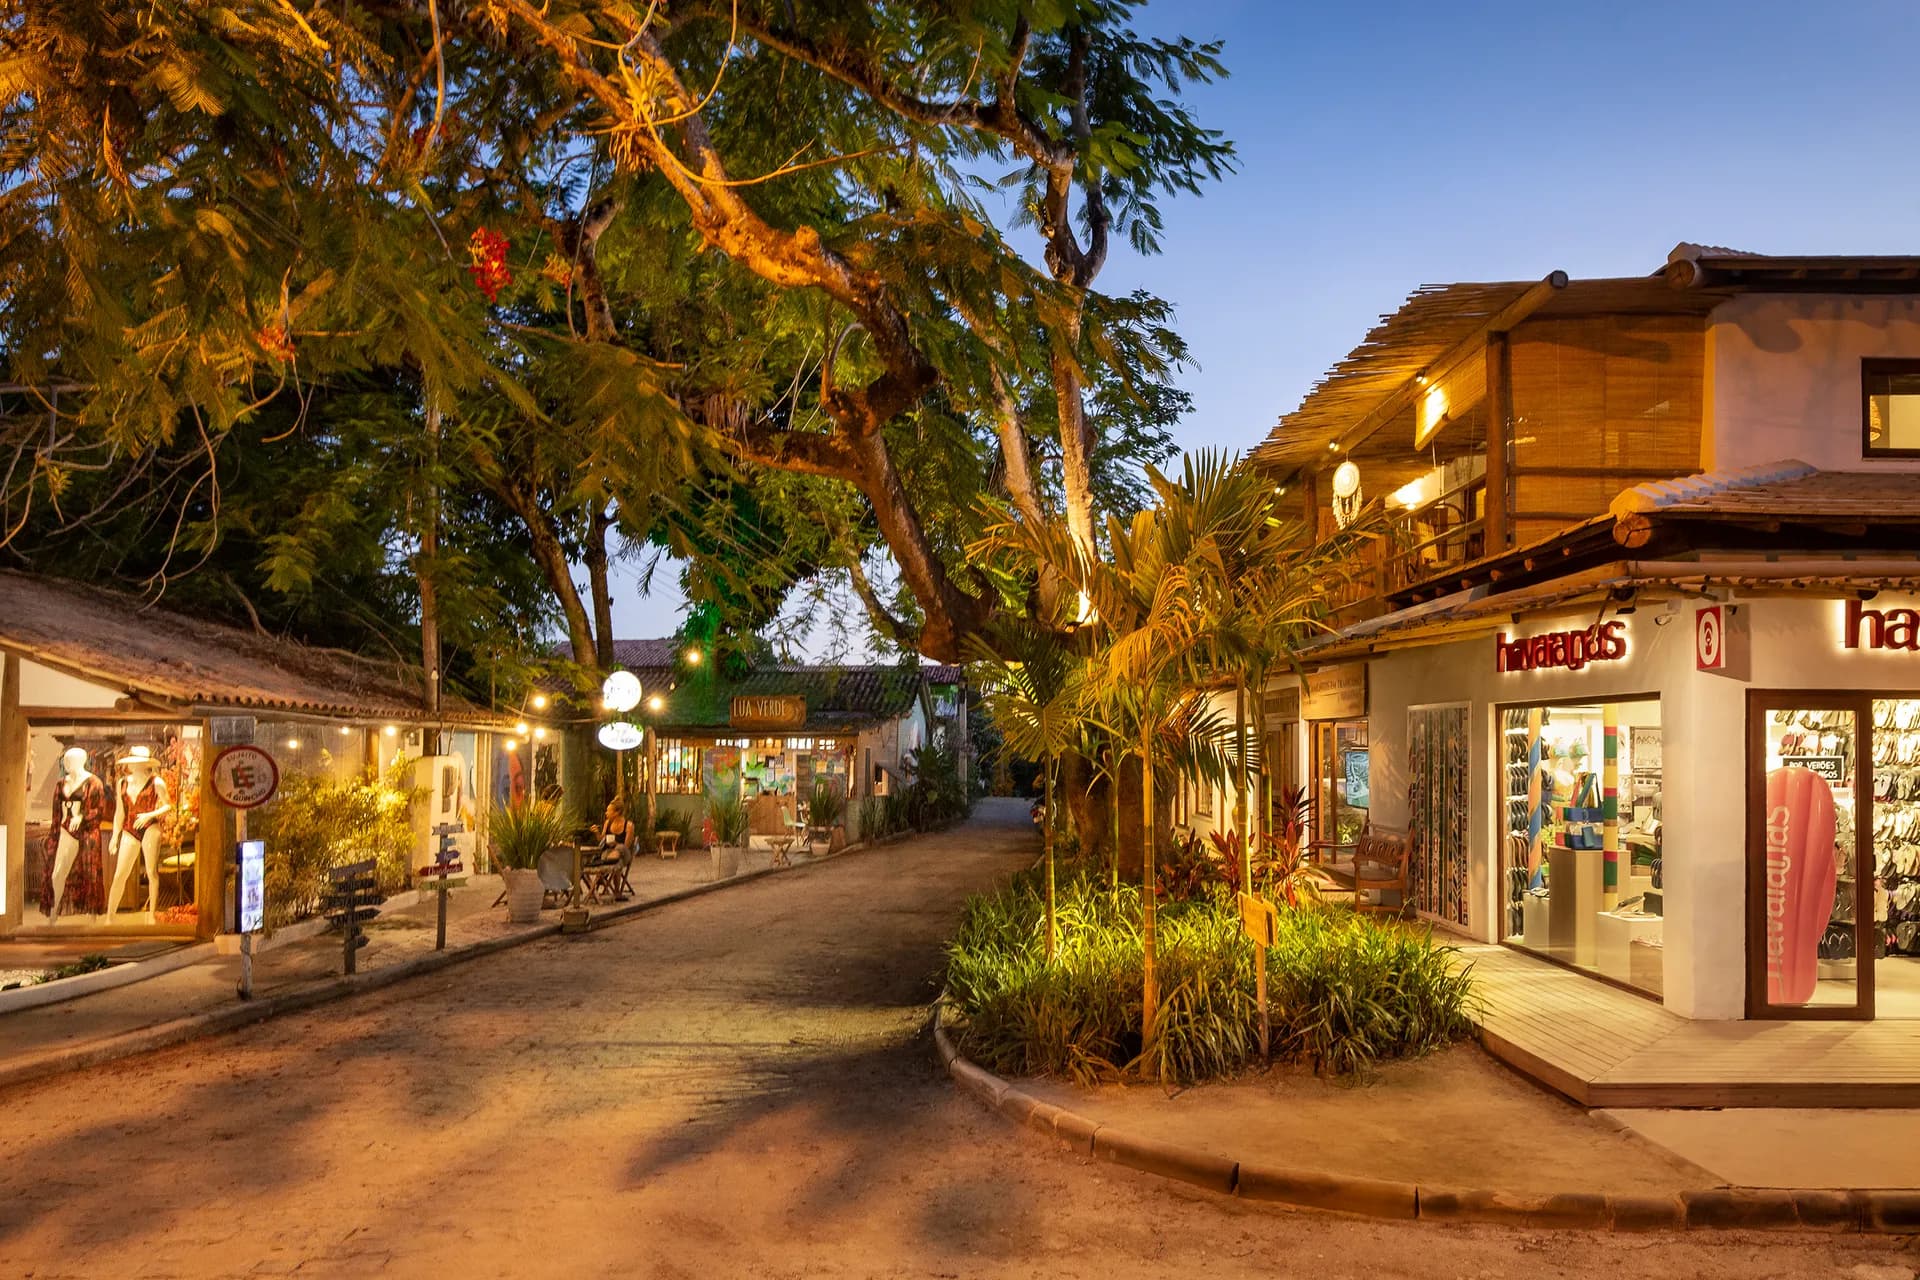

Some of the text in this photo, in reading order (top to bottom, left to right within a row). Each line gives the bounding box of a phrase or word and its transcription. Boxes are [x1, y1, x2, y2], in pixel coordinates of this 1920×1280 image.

[1845, 599, 1920, 651] ha
[733, 697, 786, 717] LUA VERDE
[1807, 760, 1836, 770] VERÕES
